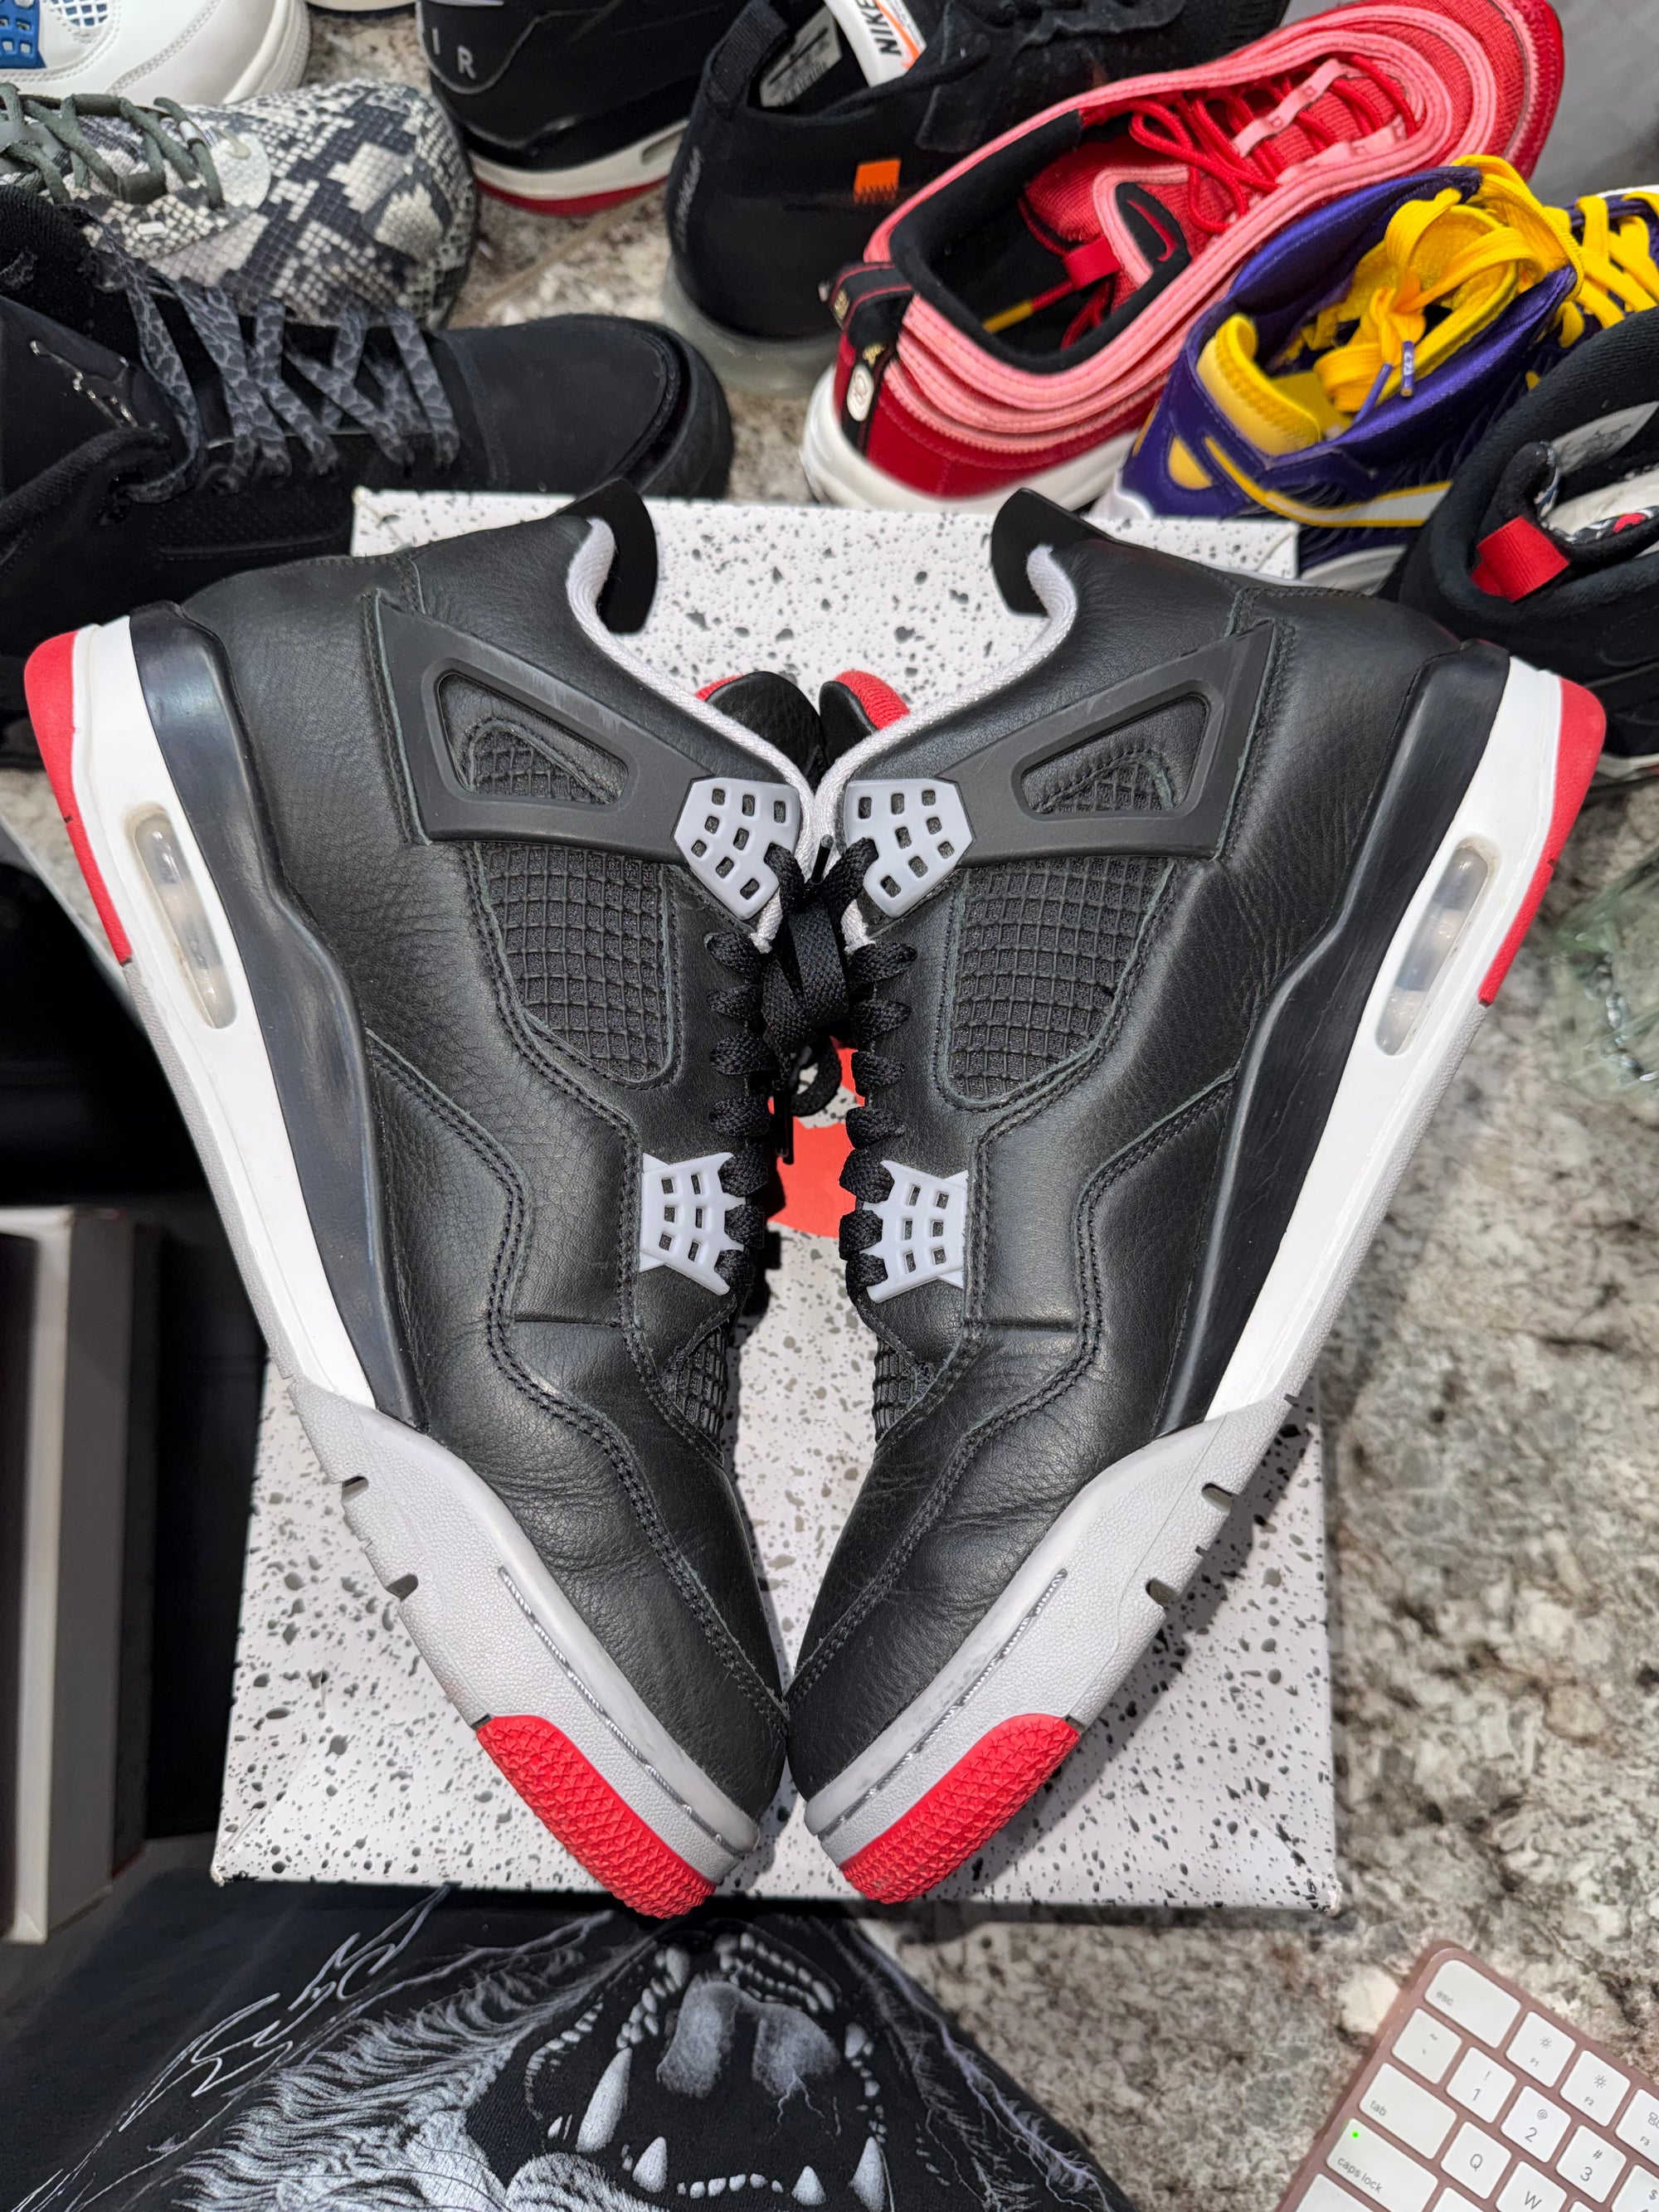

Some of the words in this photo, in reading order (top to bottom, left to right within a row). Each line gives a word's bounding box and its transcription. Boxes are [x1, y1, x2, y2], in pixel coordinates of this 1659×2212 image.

[856, 0, 902, 56] NIKE
[1436, 1991, 1454, 2006] esc
[1472, 2088, 1481, 2101] 1
[1584, 2096, 1594, 2107] F2
[1370, 2100, 1387, 2116] tab
[1525, 2127, 1537, 2142] 2
[1639, 2136, 1650, 2146] F3
[1469, 2153, 1483, 2171] Q
[1336, 2156, 1361, 2178] caps
[1360, 2172, 1383, 2194] lock
[1579, 2166, 1593, 2181] 3
[1524, 2190, 1543, 2210] W
